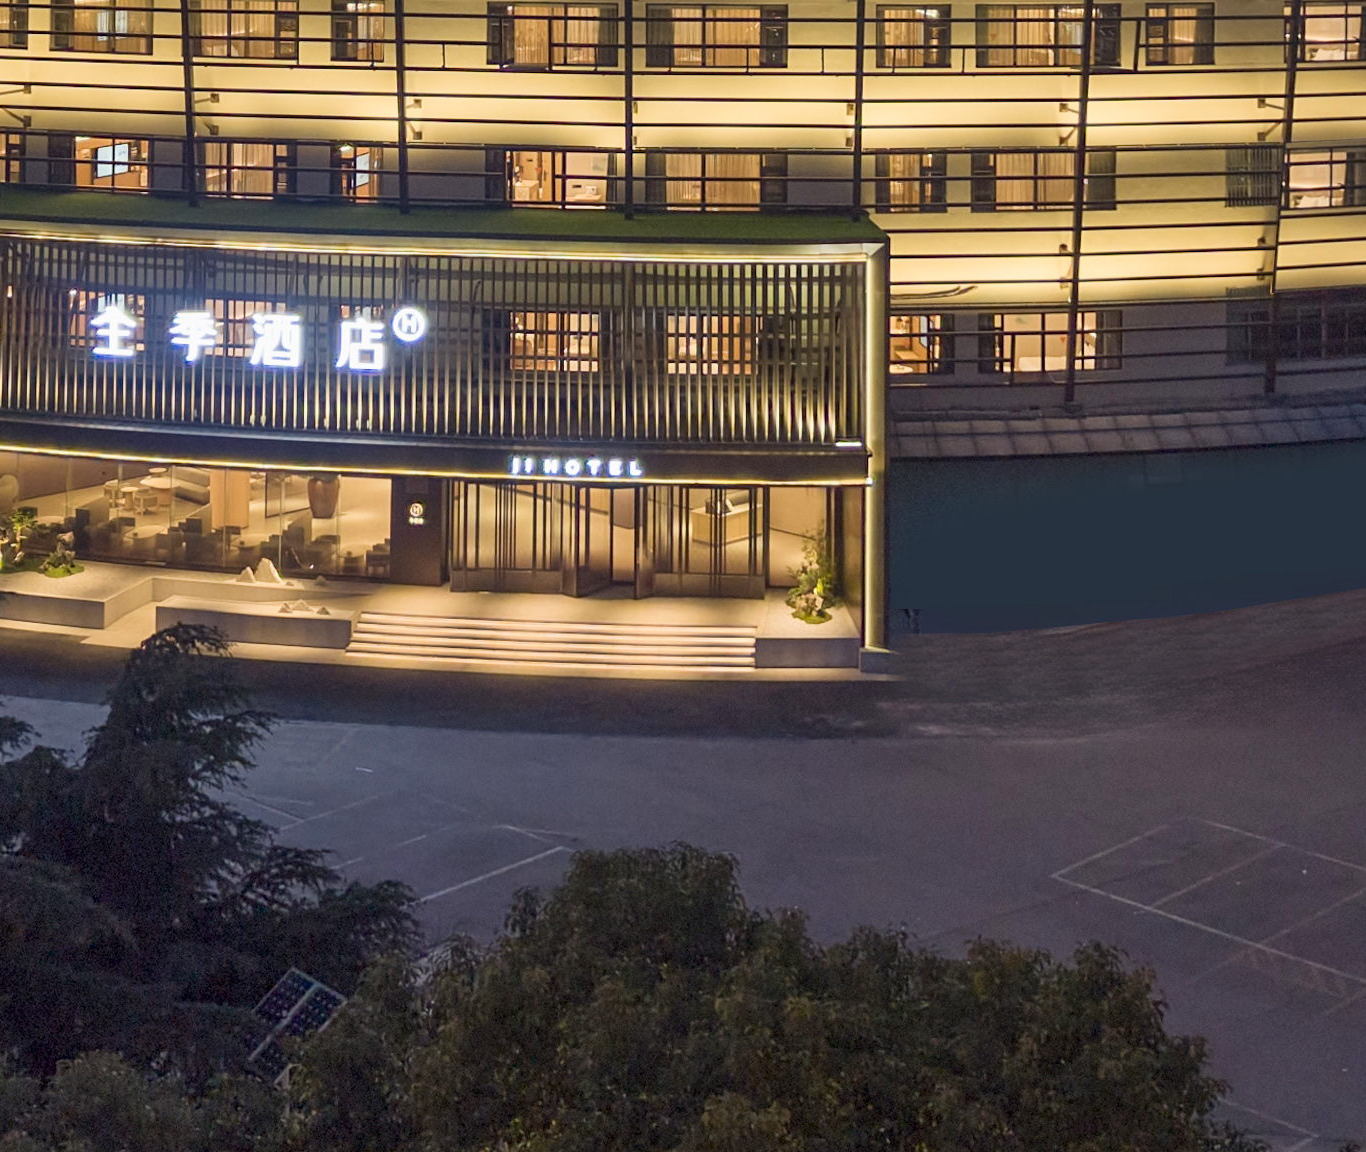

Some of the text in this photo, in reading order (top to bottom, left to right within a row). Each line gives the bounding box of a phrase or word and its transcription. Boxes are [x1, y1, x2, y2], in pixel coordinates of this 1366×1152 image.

[90, 306, 385, 371] 全季酒店
[543, 458, 643, 476] HOTEL
